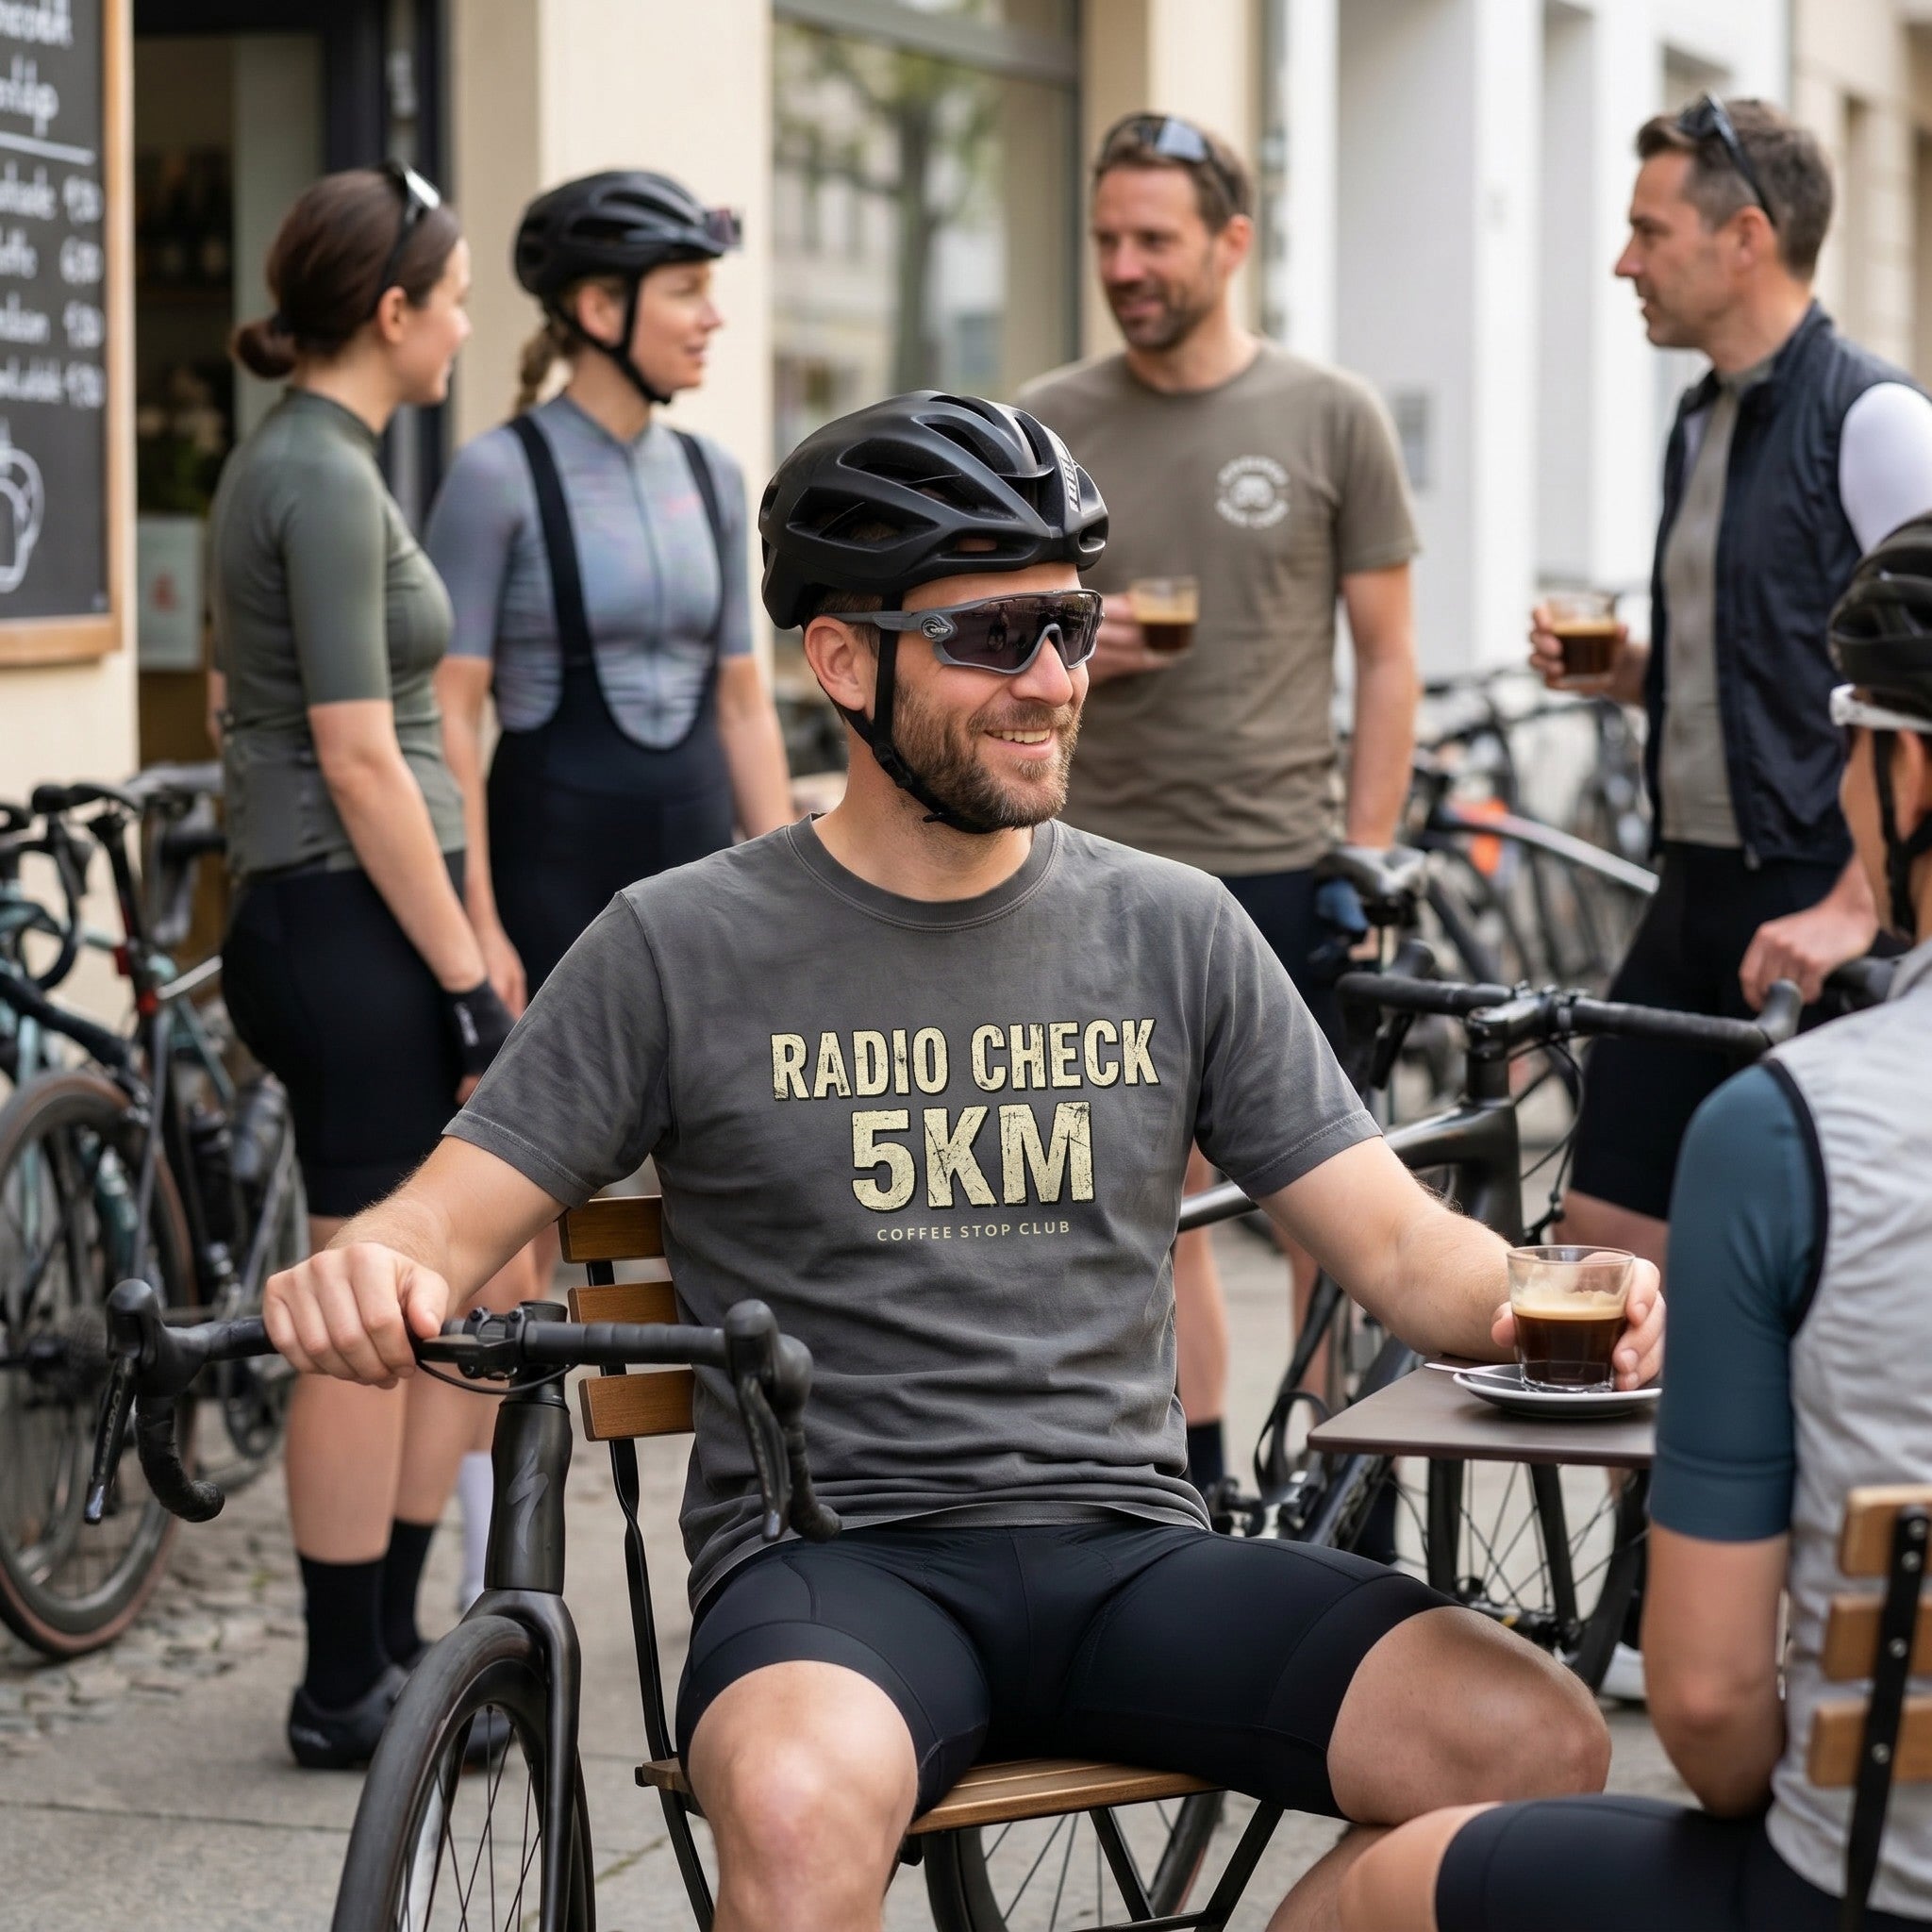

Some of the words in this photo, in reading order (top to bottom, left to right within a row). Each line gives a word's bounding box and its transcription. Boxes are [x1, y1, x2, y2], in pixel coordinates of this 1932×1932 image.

[771, 1026, 949, 1101] RADIO
[971, 1019, 1160, 1092] CHECK
[852, 1101, 1095, 1212] 5KM
[876, 1225, 952, 1241] COFFEE
[960, 1224, 1010, 1239] STOP
[1019, 1221, 1071, 1236] CLUB
